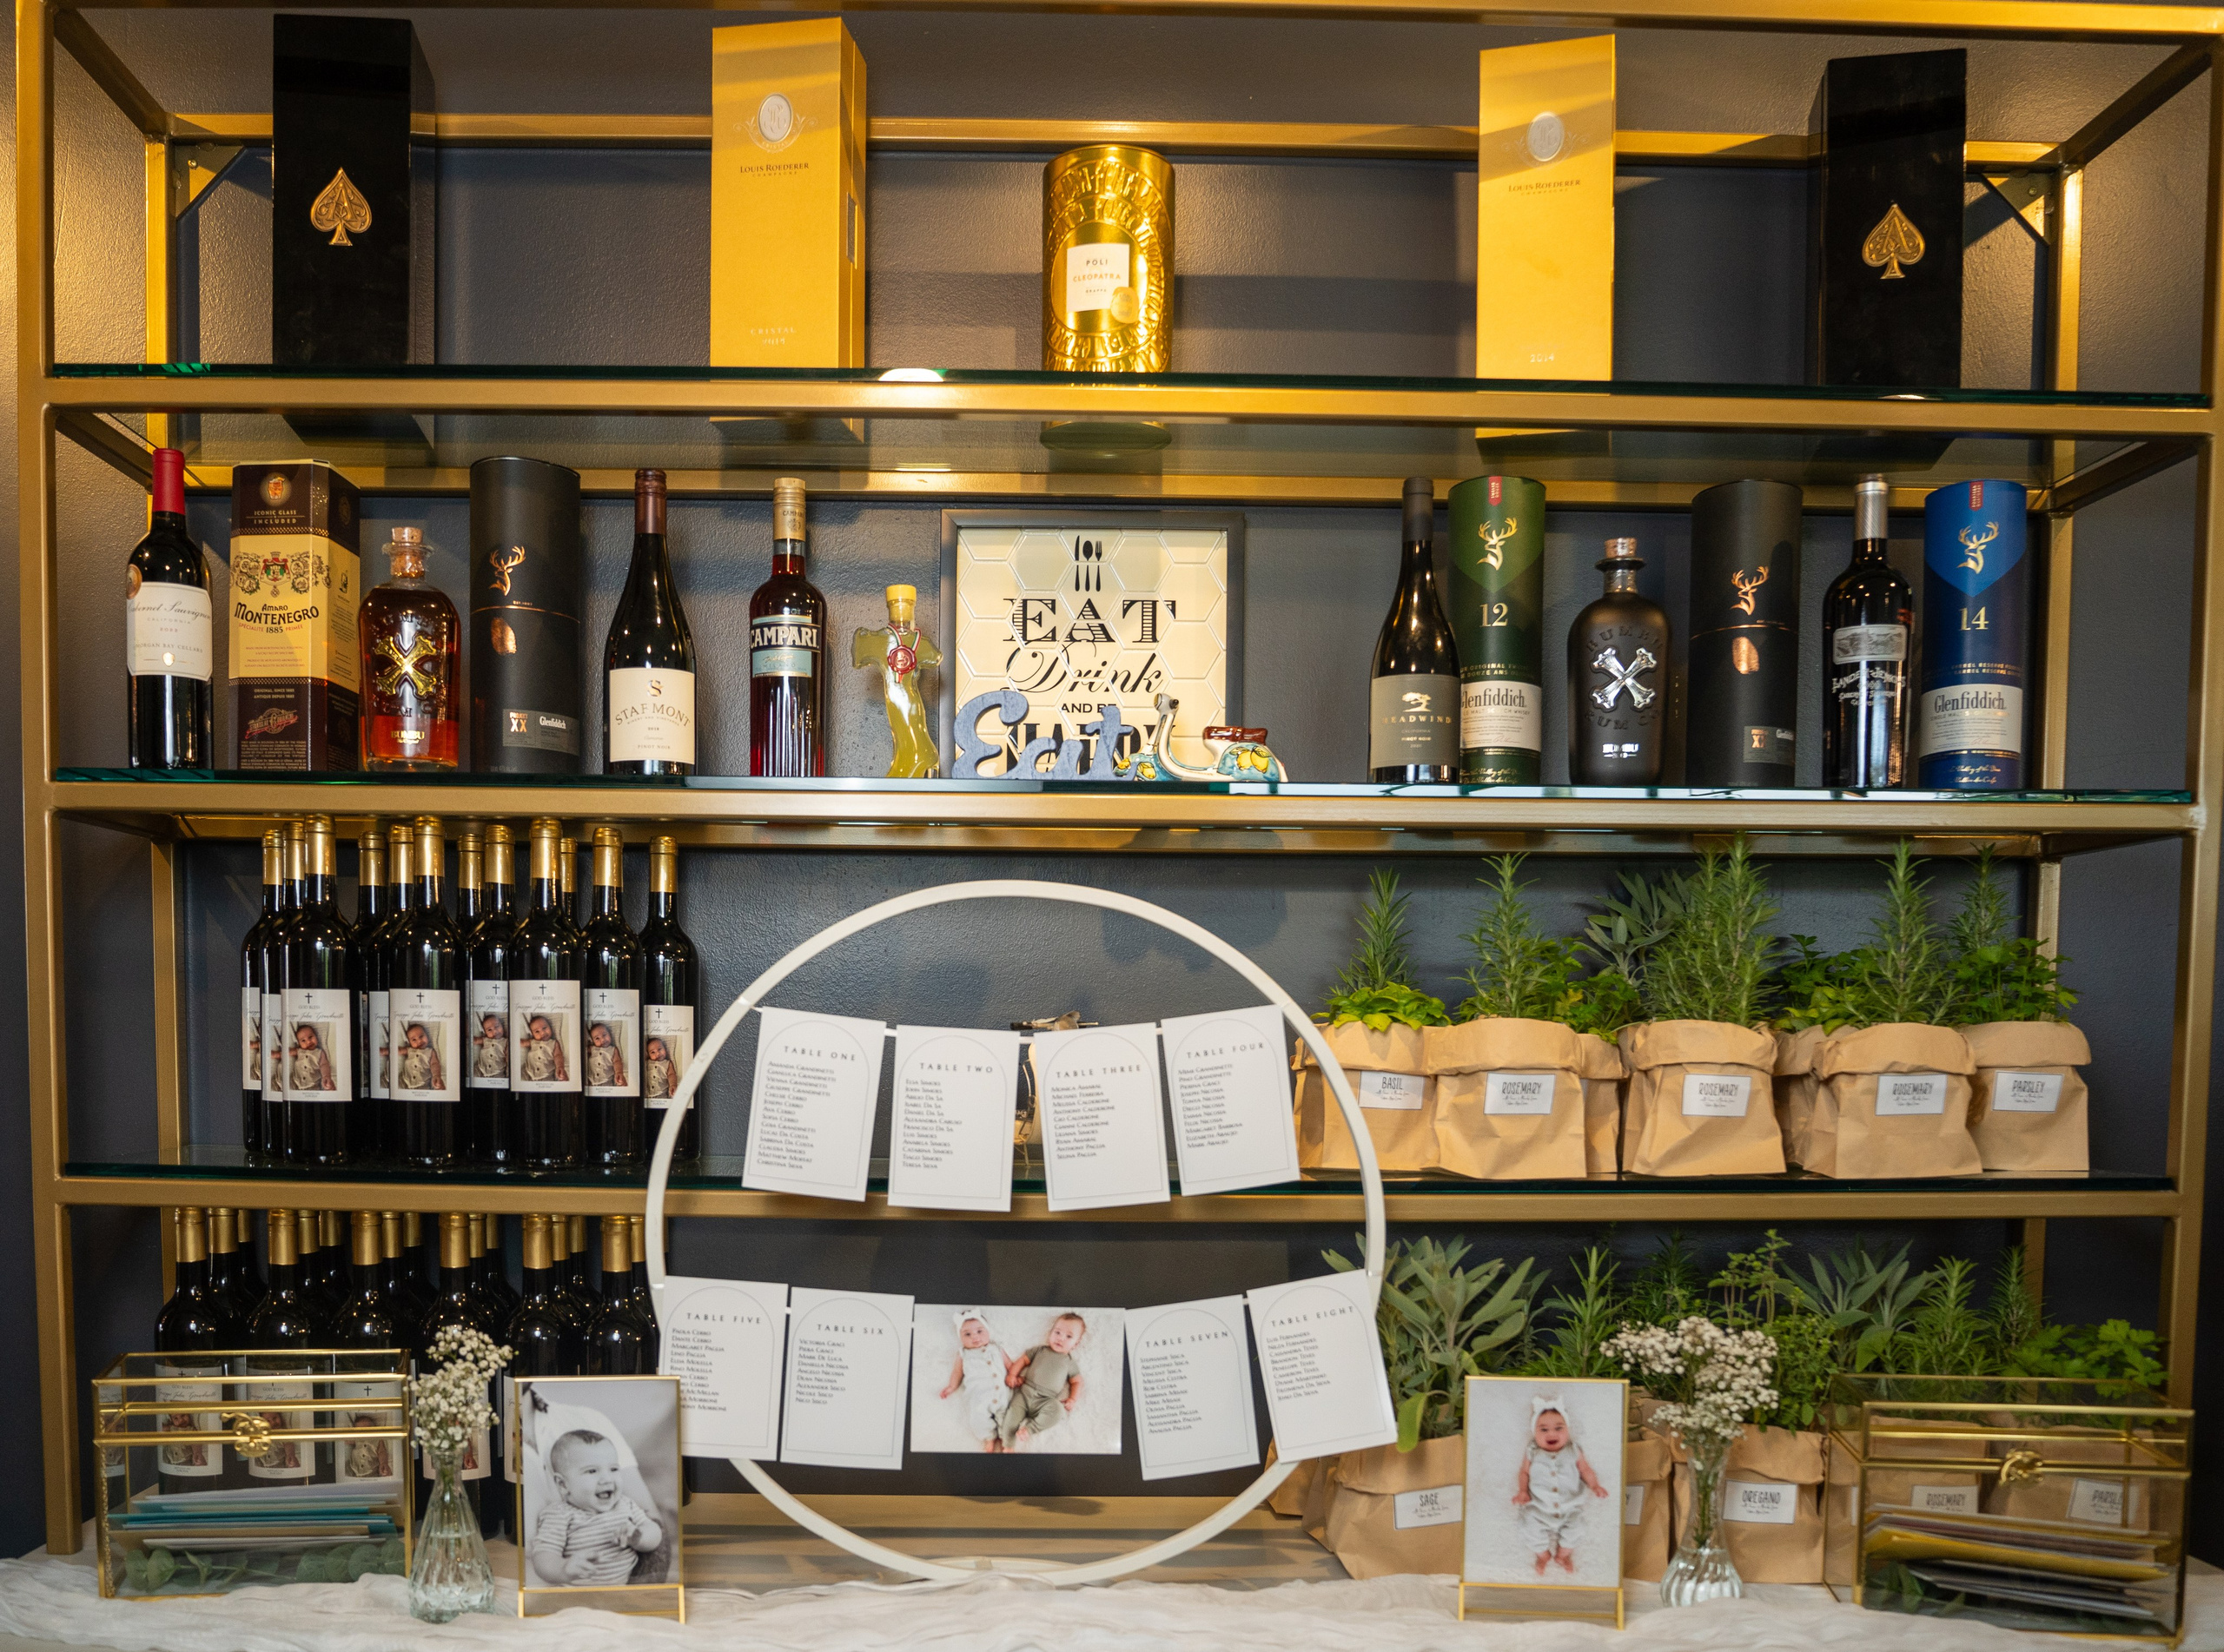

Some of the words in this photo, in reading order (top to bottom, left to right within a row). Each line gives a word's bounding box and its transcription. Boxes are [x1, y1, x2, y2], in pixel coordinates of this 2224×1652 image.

[765, 162, 810, 172] ROEDERER
[1508, 183, 1533, 192] LOUIS
[1535, 180, 1580, 189] ROEDERER
[1073, 274, 1122, 282] CLEOPATRA
[751, 327, 797, 335] CRISTAL
[235, 602, 319, 625] MONTENEGRO
[1003, 598, 1176, 643] EAT
[1479, 602, 1509, 628] 12
[1958, 605, 1989, 631] 14
[177, 644, 203, 653] CELLARS
[999, 640, 1163, 693] Drink
[1061, 703, 1093, 713] AND
[1935, 691, 2006, 713] Glenfiddich
[510, 718, 527, 732] XX
[539, 716, 566, 730] Glenfiddich
[951, 690, 1139, 780] Eat
[784, 1045, 822, 1058] TABLE
[831, 1051, 857, 1061] ONE
[1186, 1047, 1224, 1059] TABLE
[1232, 1042, 1264, 1054] FOUR
[919, 1062, 958, 1072] TABLE
[967, 1065, 993, 1074] TWO
[1056, 1067, 1094, 1079] TABLE
[1102, 1064, 1142, 1075] THREE
[1381, 1077, 1403, 1090] BASIL
[1502, 1081, 1542, 1094] ROSEMARY
[1698, 1082, 1739, 1097] ROSEMARY
[1892, 1081, 1935, 1095] ROSEMARY
[2011, 1080, 2046, 1094] PARSLEY
[686, 1312, 725, 1322] TABLE
[733, 1315, 762, 1325] FIVE
[1271, 1314, 1308, 1328] TABLE
[1316, 1305, 1354, 1319] EIGHT
[817, 1323, 855, 1333] TABLE
[863, 1326, 884, 1335] SIX
[1146, 1336, 1182, 1348] TABLE
[1190, 1331, 1228, 1342] SEVEN
[1419, 1492, 1439, 1507] SAGE
[1742, 1490, 1781, 1504] OREGANO
[1926, 1493, 1966, 1507] ROSEMARY
